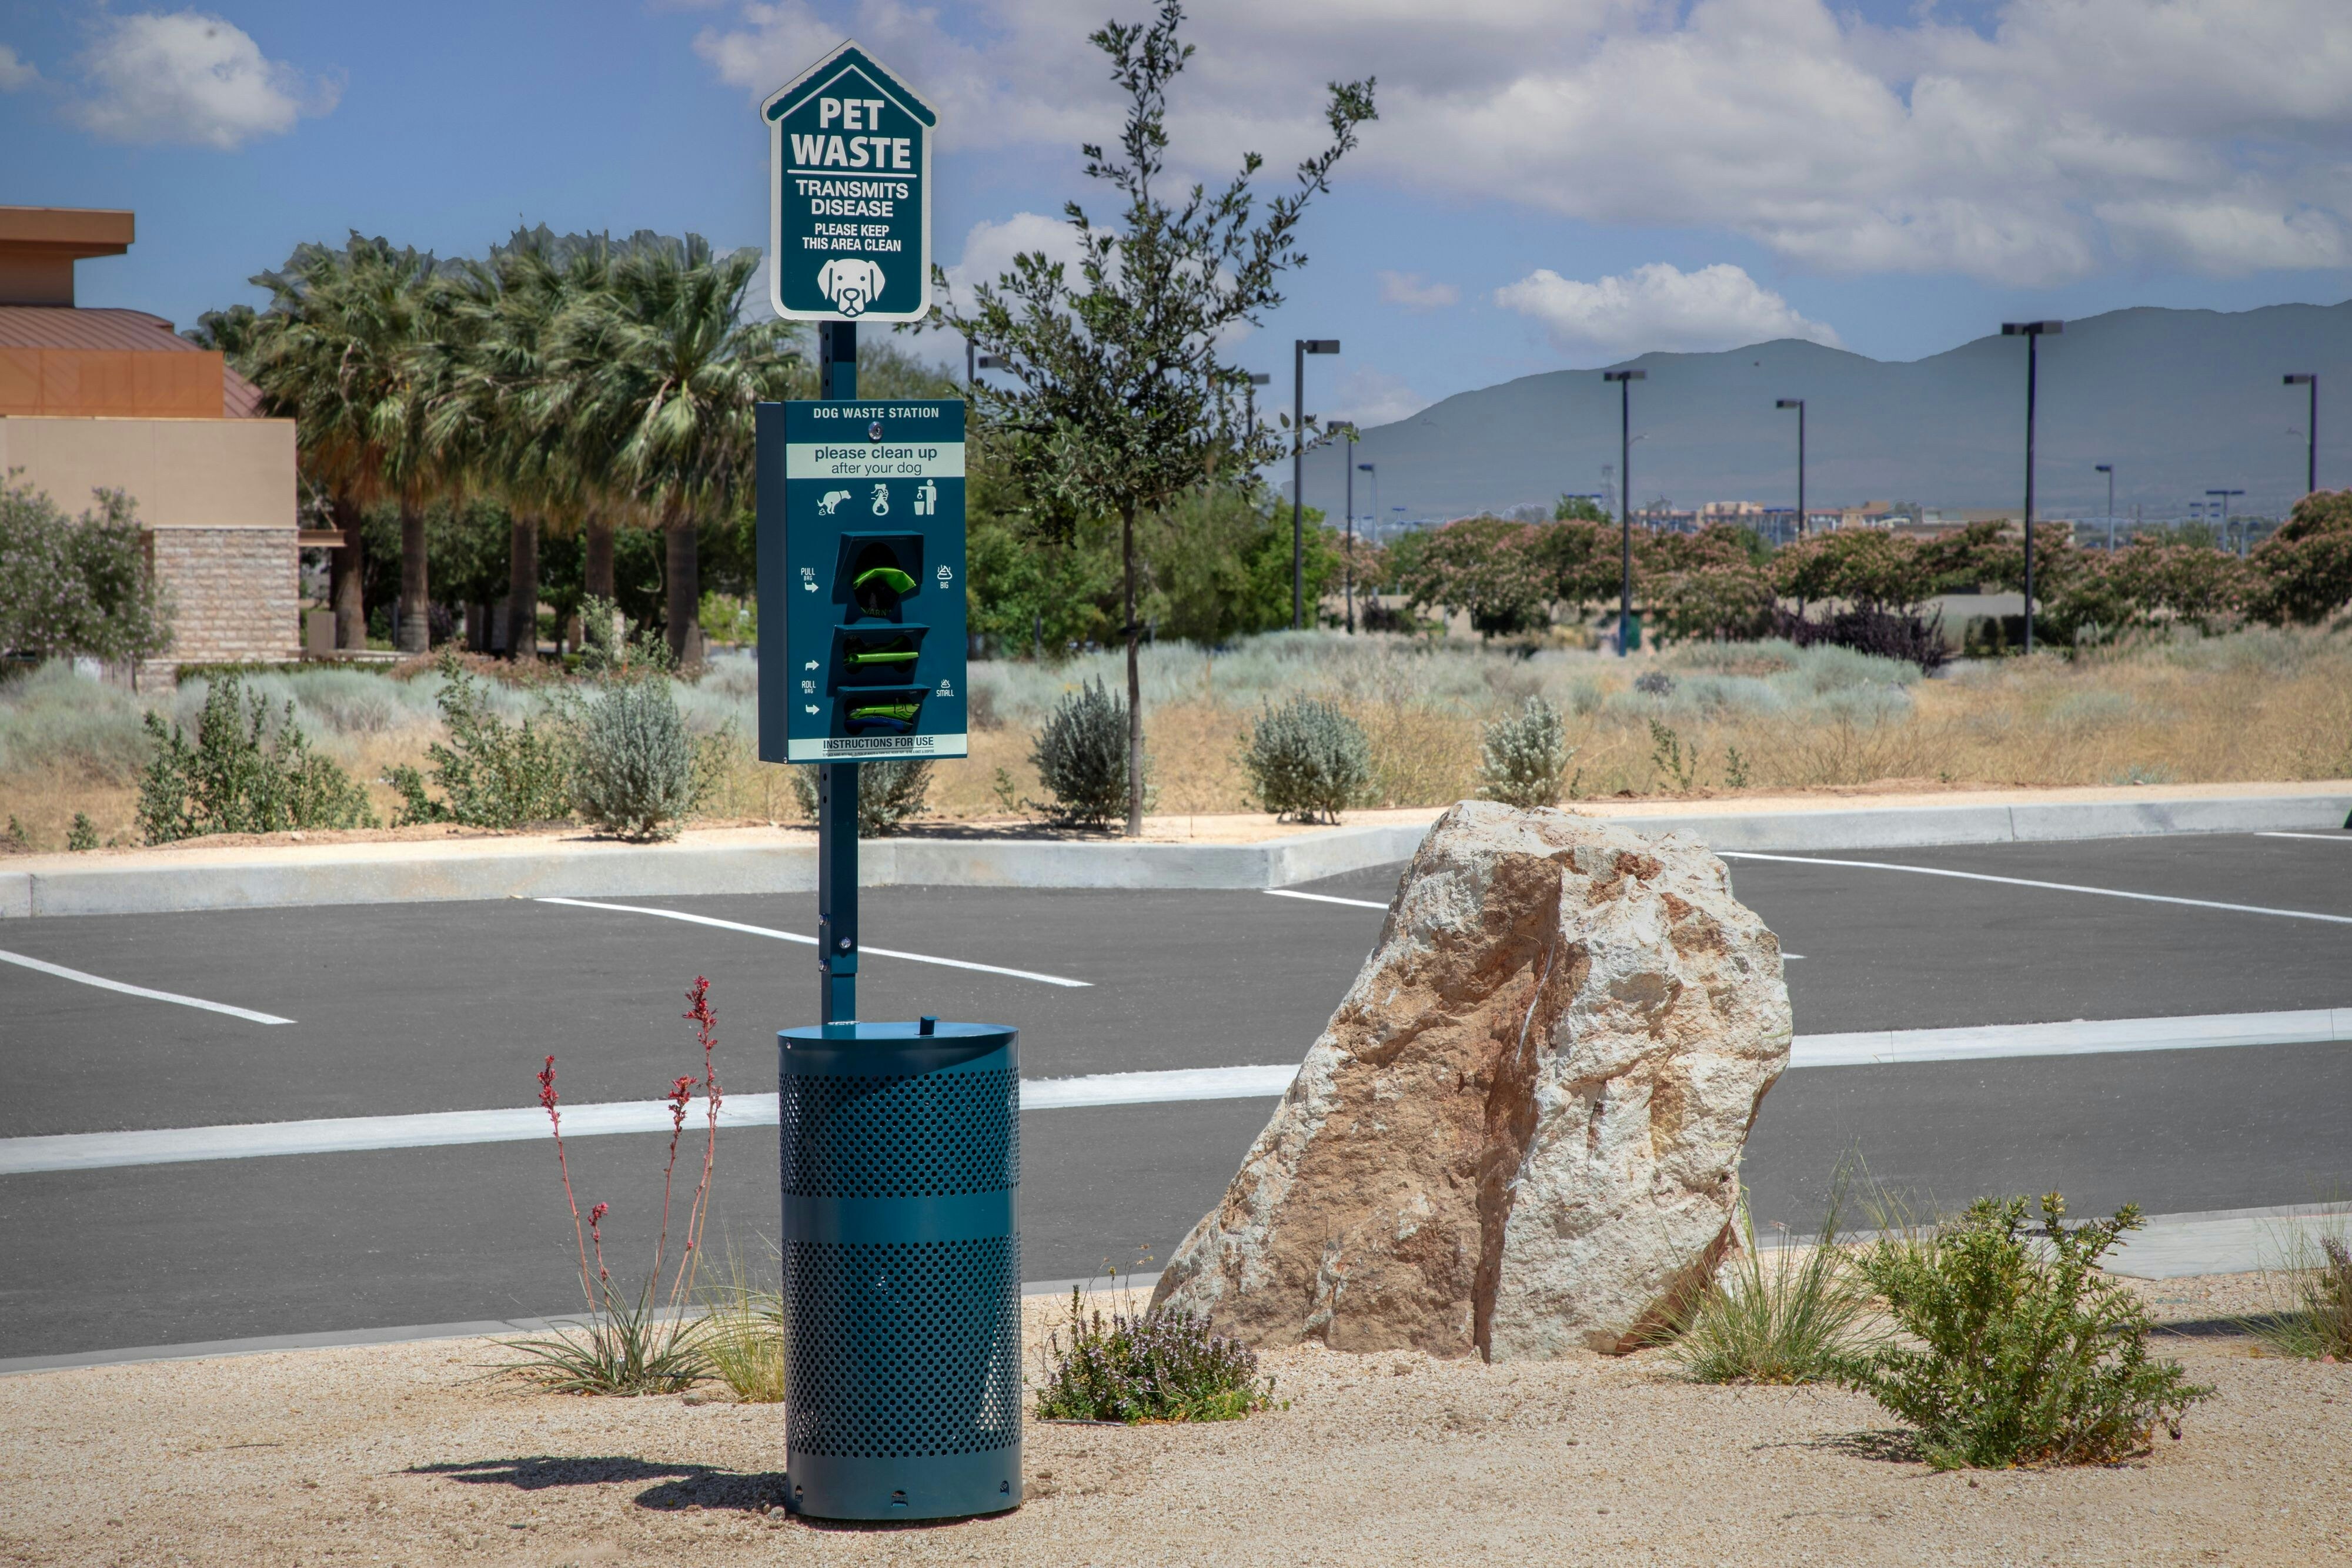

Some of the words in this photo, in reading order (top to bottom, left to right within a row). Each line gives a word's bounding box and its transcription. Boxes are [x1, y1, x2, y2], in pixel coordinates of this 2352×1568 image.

[820, 98, 884, 130] PET
[791, 134, 910, 168] WASTE
[796, 179, 908, 199] TRANSMITS
[811, 199, 893, 217] DISEASE
[815, 223, 857, 236] PLEASE
[861, 225, 889, 237] KEEP
[803, 238, 828, 249] THIS
[831, 238, 861, 250] AREA
[865, 239, 901, 251] CLEAN
[814, 408, 838, 418] DOG
[843, 408, 884, 418] WASTE
[889, 407, 938, 418] STATION
[815, 446, 866, 462] please
[871, 446, 913, 459] clean
[918, 449, 937, 461] up
[831, 462, 861, 474] after
[864, 464, 893, 476] your
[897, 462, 921, 476] dog
[801, 567, 815, 576] PULL
[824, 738, 892, 748] INSTRUCTIONS
[896, 738, 913, 747] FOR
[916, 737, 933, 745] USE
